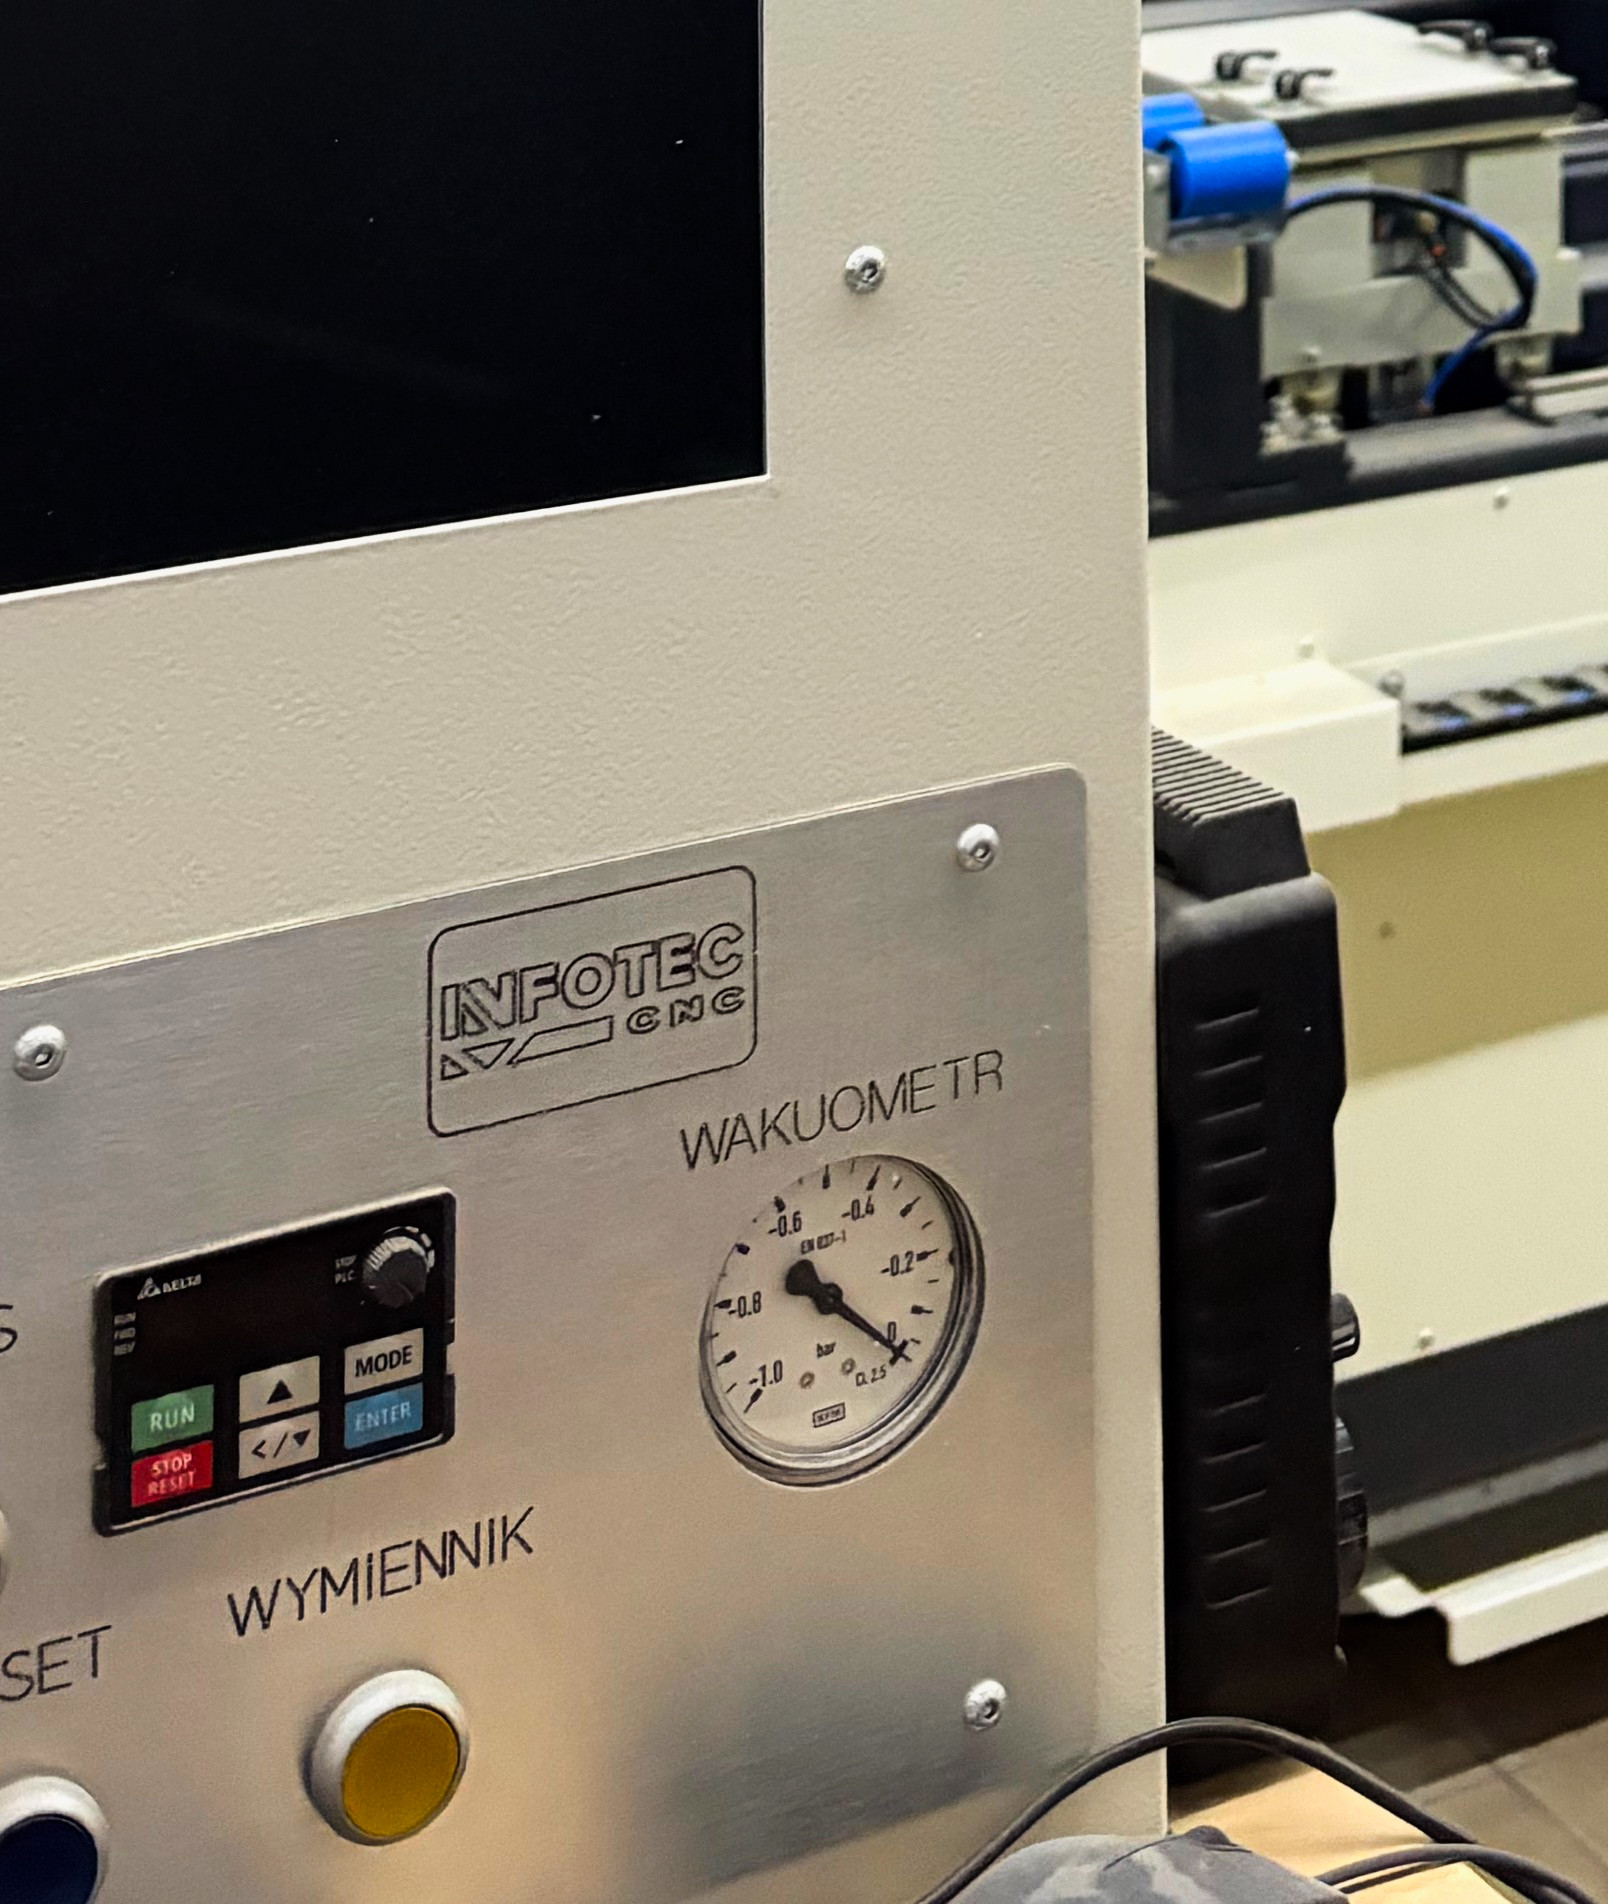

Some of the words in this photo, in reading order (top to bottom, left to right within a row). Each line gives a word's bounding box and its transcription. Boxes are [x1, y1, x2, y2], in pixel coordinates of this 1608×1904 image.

[440, 922, 745, 1041] INFOTEC
[626, 986, 746, 1034] CNC
[679, 1049, 1004, 1170] WAKUOMETR
[354, 1345, 414, 1378] MODE
[150, 1404, 195, 1433] RUN
[354, 1400, 412, 1432] ENTER
[148, 1470, 195, 1497] RESET
[151, 1453, 193, 1477] STOP
[227, 1505, 535, 1637] WYMIENNIK
[1, 1624, 113, 1702] SET
